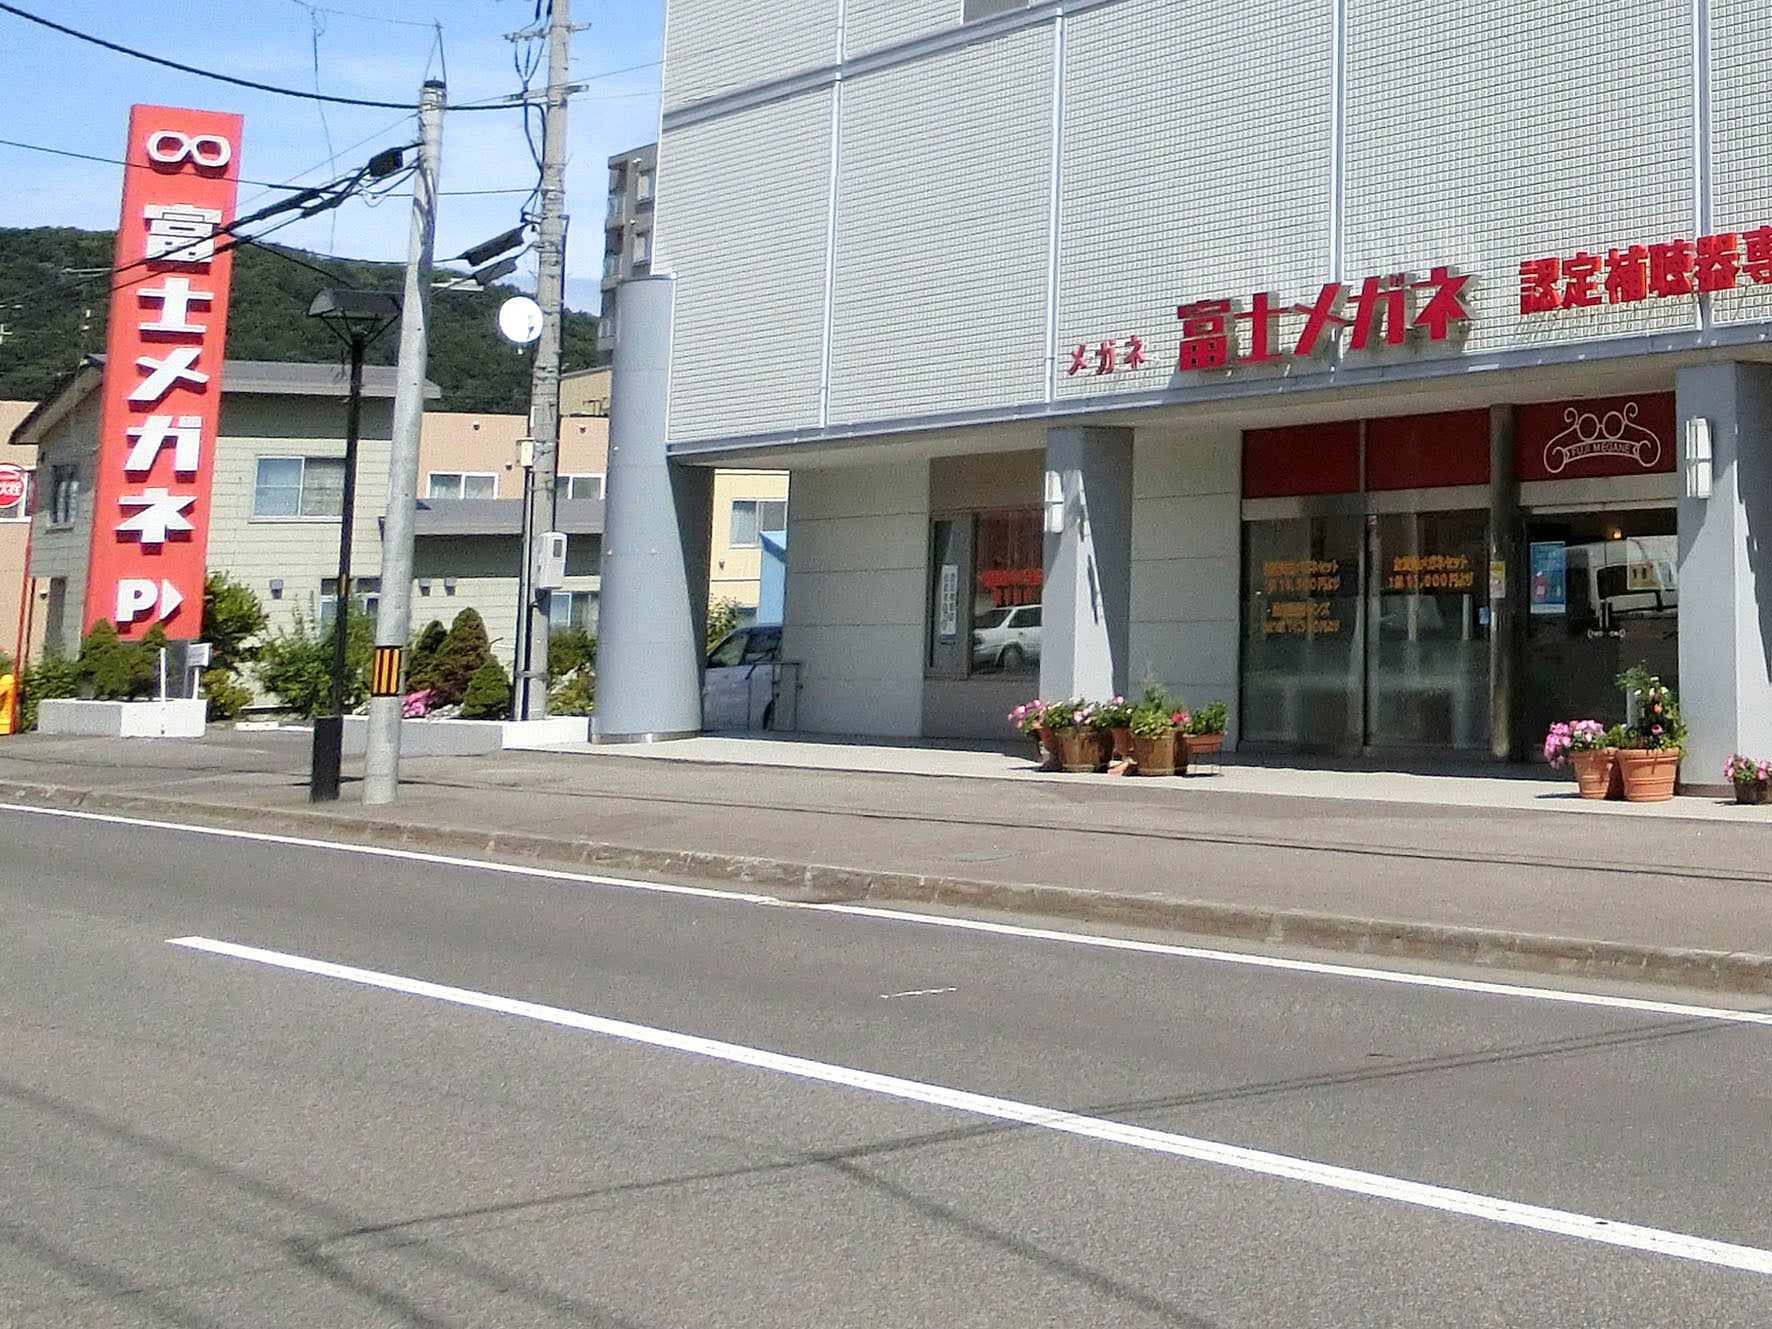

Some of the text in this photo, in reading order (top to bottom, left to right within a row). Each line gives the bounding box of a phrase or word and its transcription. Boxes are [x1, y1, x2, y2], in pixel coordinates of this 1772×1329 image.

[1177, 266, 1476, 372] 富士メガネ
[114, 203, 222, 544] 富士メガネ
[1068, 334, 1146, 376] メガネ
[1571, 442, 1631, 456] FUJI MEGANE
[114, 577, 159, 622] P
